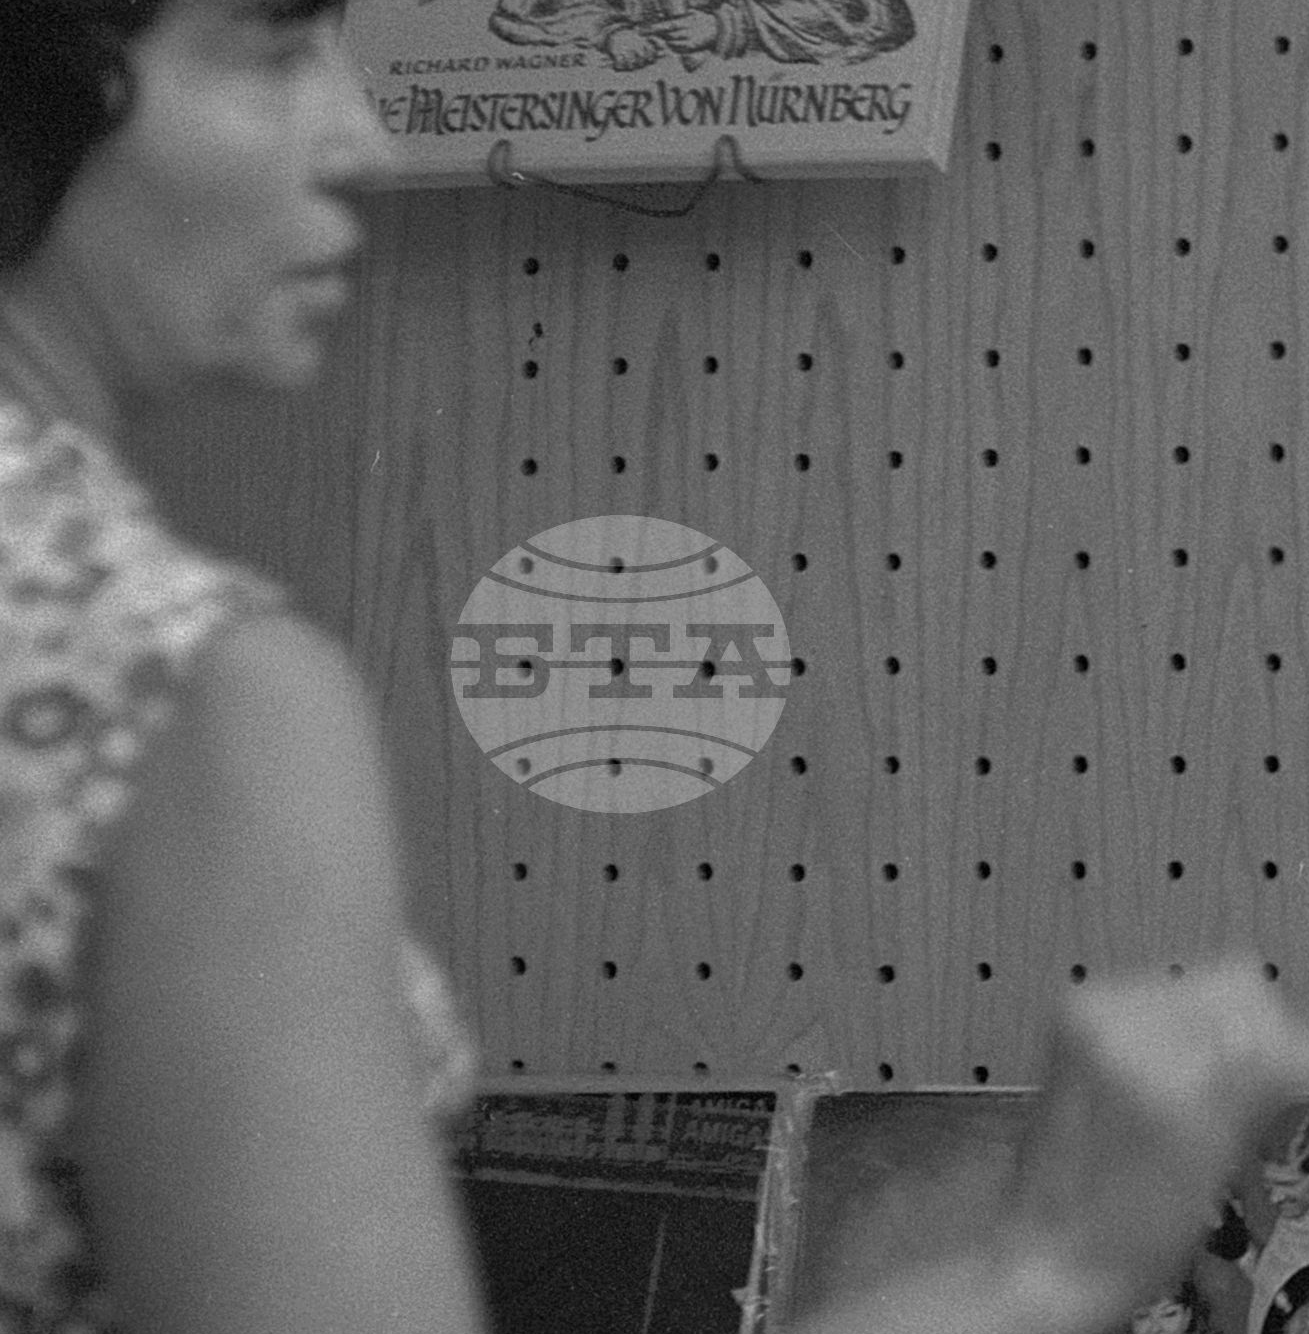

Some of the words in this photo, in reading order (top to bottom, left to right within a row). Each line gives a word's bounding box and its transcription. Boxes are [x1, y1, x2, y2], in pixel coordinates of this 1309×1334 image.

[390, 57, 490, 76] RICHARD
[497, 53, 586, 69] WAGNER
[405, 83, 653, 143] MEISTERSINGER
[655, 78, 725, 126] VON
